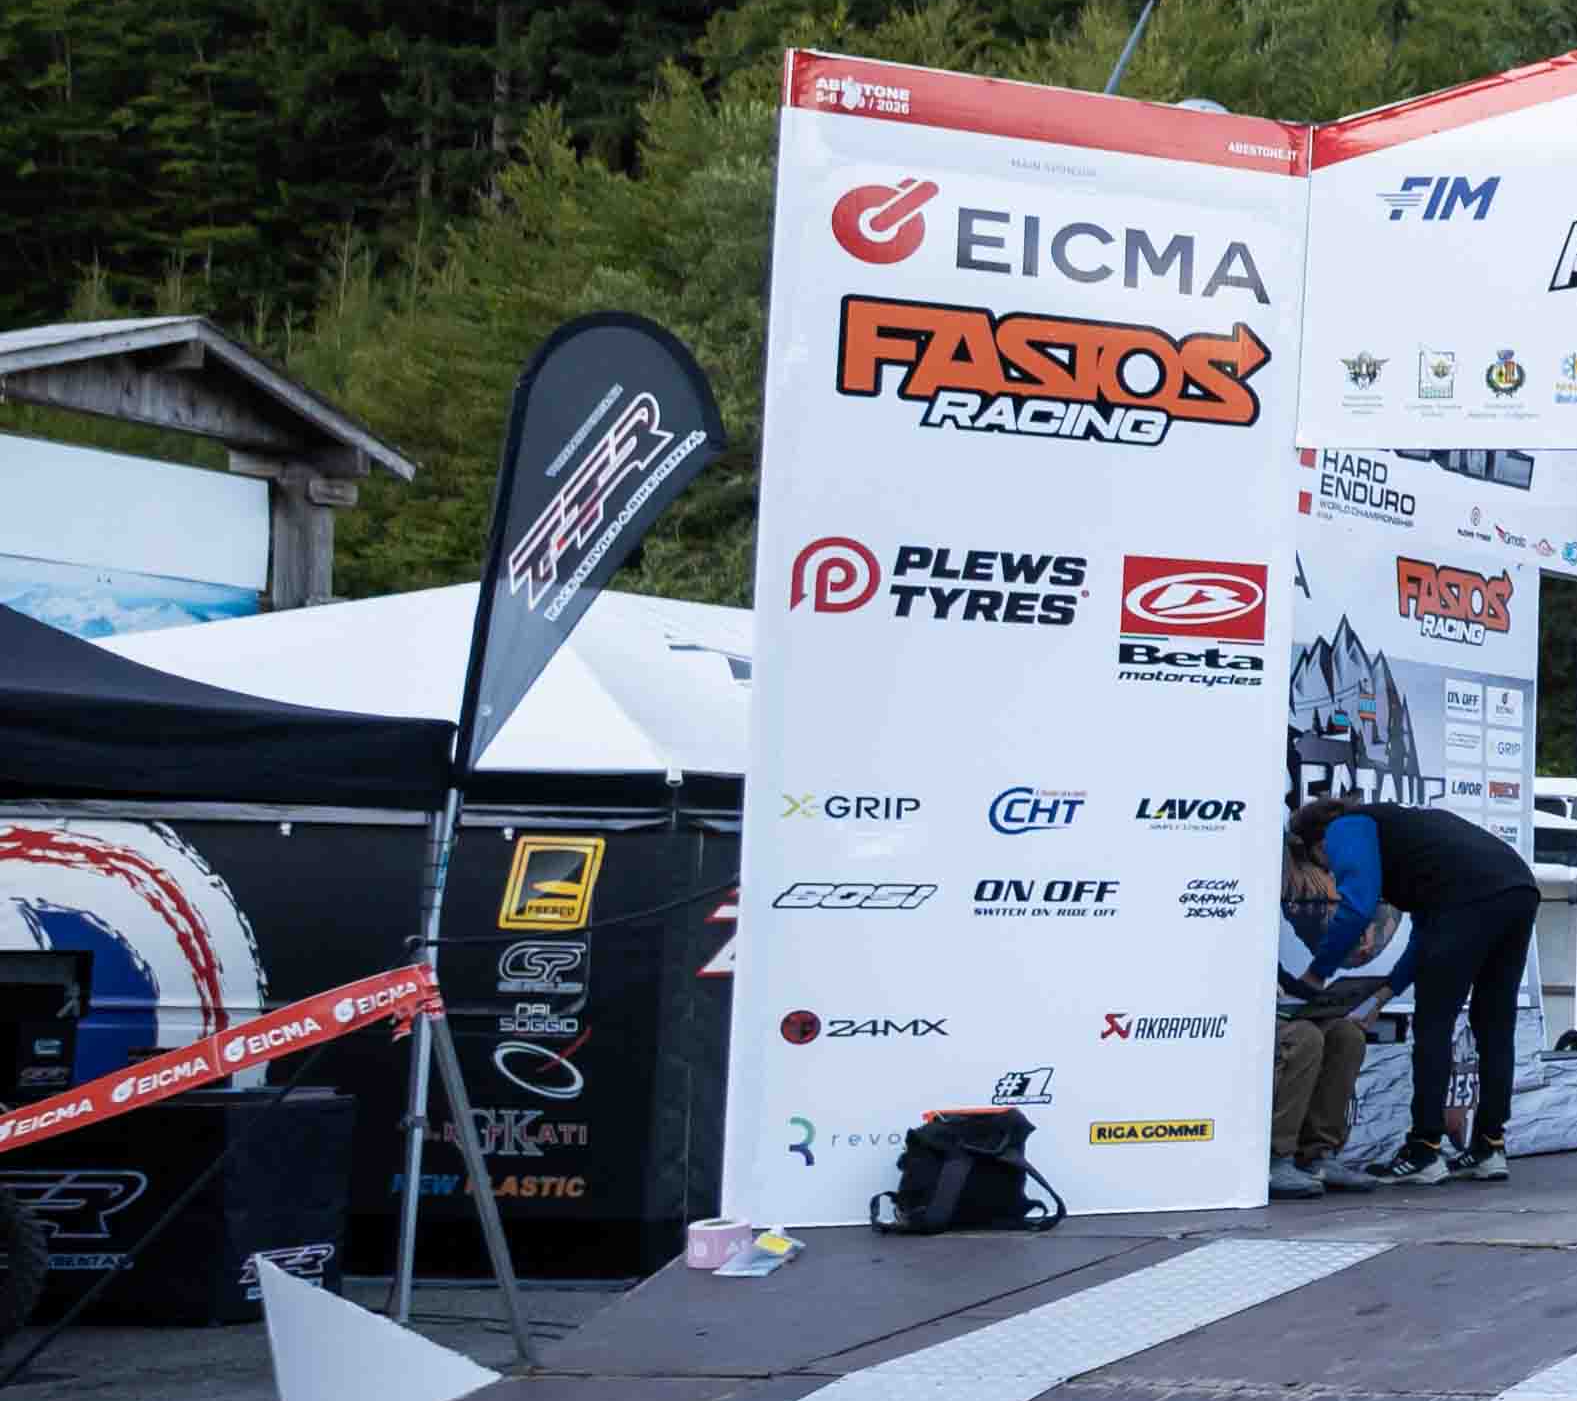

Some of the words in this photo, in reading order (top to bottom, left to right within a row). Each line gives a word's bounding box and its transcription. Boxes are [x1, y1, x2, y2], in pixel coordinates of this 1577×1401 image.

[816, 76, 911, 101] ABTONE
[1389, 176, 1501, 222] FIM
[957, 206, 1271, 305] EICMA
[920, 391, 1172, 446] RACING
[1322, 448, 1389, 484] HARD
[1320, 473, 1417, 516] ENDURO
[892, 544, 1089, 588] PLEWS
[889, 585, 1078, 627] TYRES
[1420, 613, 1487, 647] RACING
[1118, 642, 1265, 672] Beta
[1117, 669, 1264, 688] motorcycles
[1135, 797, 1247, 822] LAVOR
[973, 879, 1036, 903] ON
[1042, 879, 1121, 903] OFF
[973, 907, 1027, 918] SWITCH
[1031, 907, 1051, 918] ON
[1056, 908, 1089, 918] RIDE
[1093, 908, 1118, 918] OFF
[356, 981, 420, 1018] EICMA
[245, 1016, 322, 1059] EICMA
[826, 1017, 950, 1039] 24MX
[136, 1056, 210, 1096] EICMA
[996, 1067, 1054, 1097] #1
[13, 1098, 94, 1137] EICMA
[1096, 1124, 1139, 1141] RIGA
[1141, 1122, 1209, 1140] GOMME
